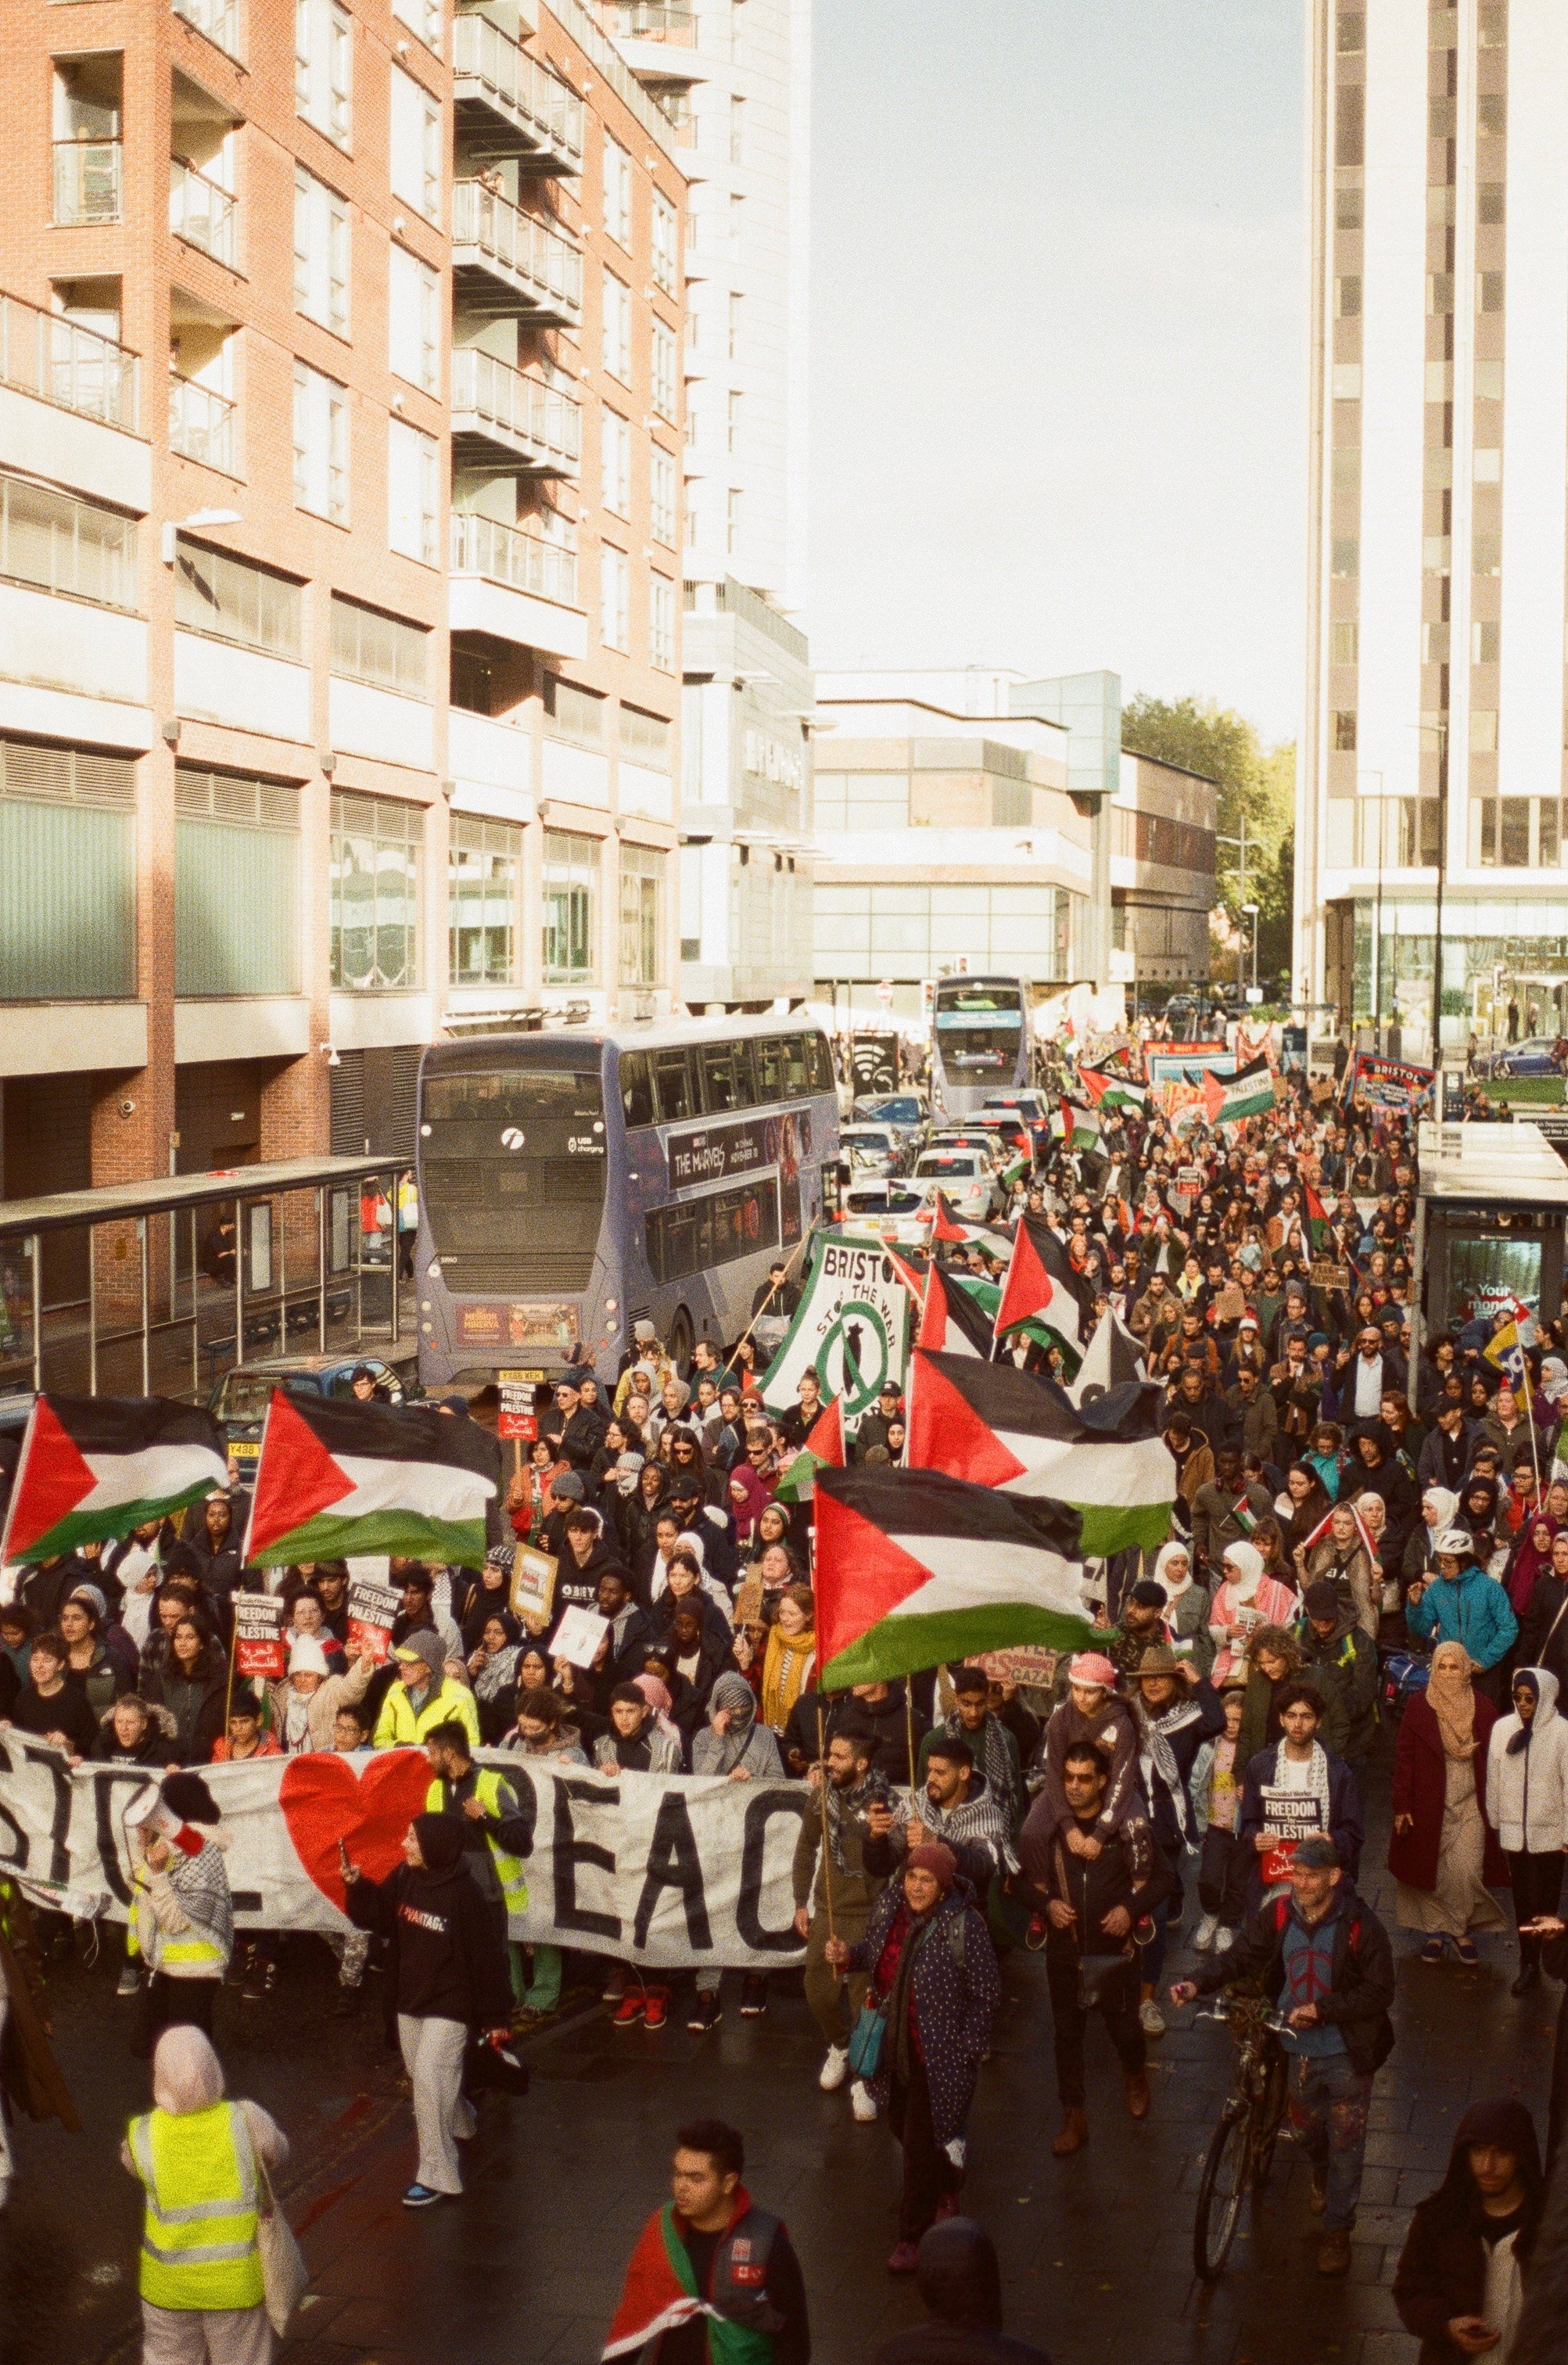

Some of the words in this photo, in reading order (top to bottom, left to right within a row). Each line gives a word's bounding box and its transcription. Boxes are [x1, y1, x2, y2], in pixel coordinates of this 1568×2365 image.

[1374, 1064, 1419, 1084] BRISTOL
[675, 1153, 691, 1176] THE
[1478, 1283, 1512, 1297] Your
[816, 1290, 843, 1335] STO
[852, 1284, 877, 1304] THE
[881, 1299, 896, 1348] WAR
[502, 1389, 532, 1402] FREEDOM
[501, 1402, 534, 1416] PALESTINE
[353, 1585, 400, 1611] FREEDOM
[562, 1584, 595, 1598] OBEY
[348, 1603, 396, 1629] PALESTINE
[1011, 1667, 1050, 1685] GAZA
[1265, 1800, 1317, 1816] FREEDOM
